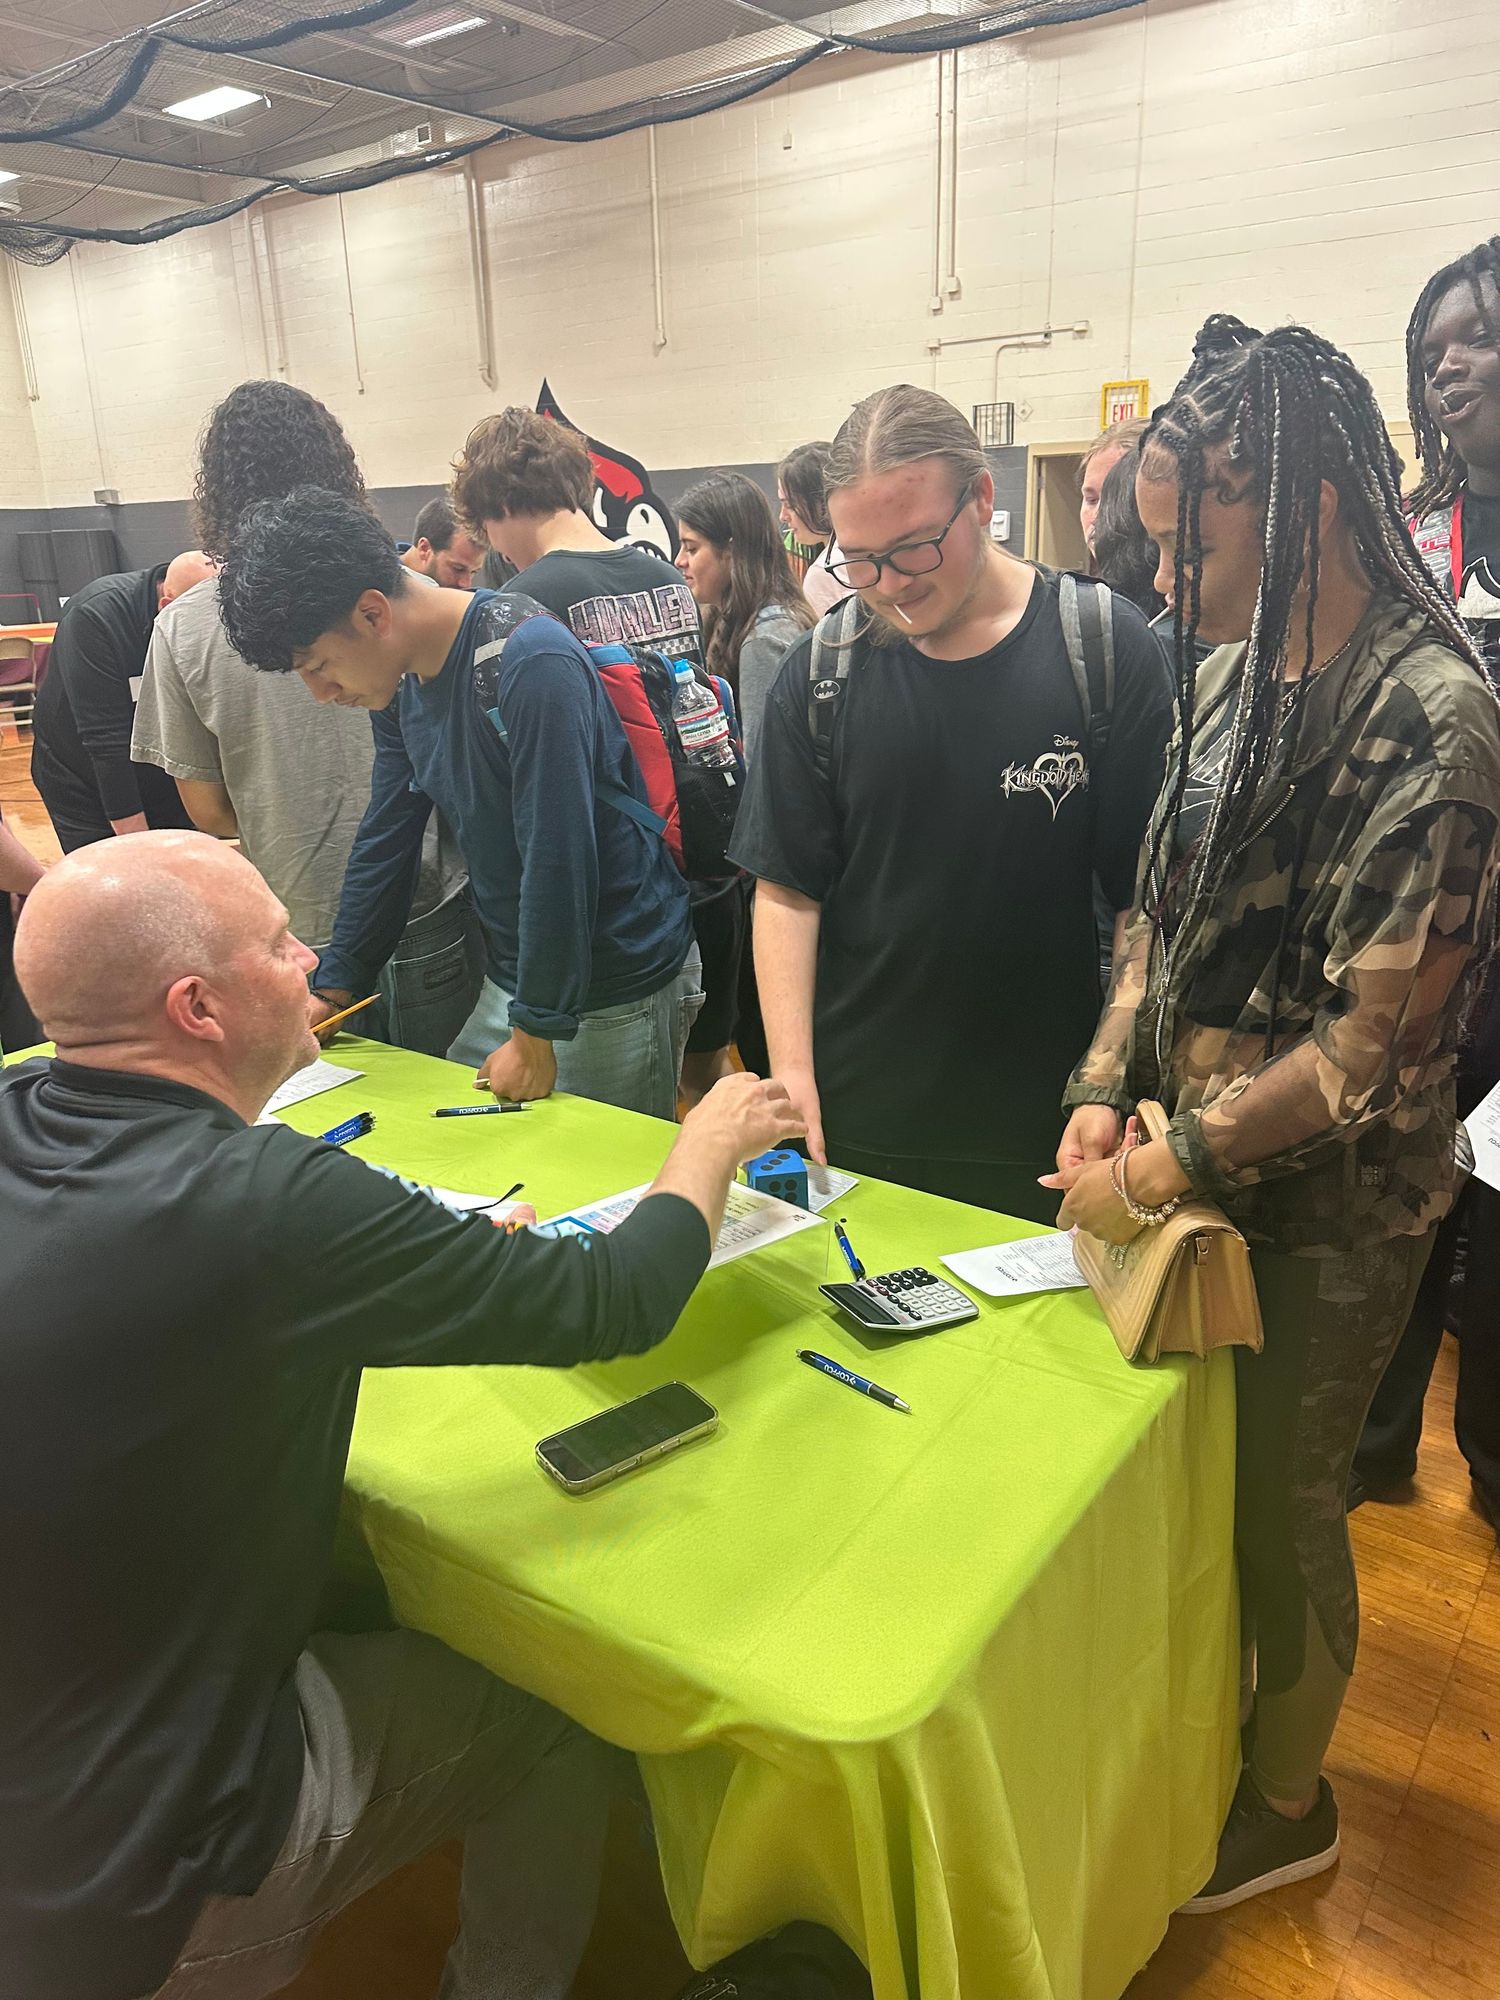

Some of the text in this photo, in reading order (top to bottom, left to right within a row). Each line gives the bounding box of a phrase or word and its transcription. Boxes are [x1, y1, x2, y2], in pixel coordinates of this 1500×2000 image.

[1113, 404, 1134, 422] EXIT
[568, 584, 699, 643] HURLEY
[1053, 734, 1079, 749] Disney
[1000, 761, 1069, 799] KINGDOM
